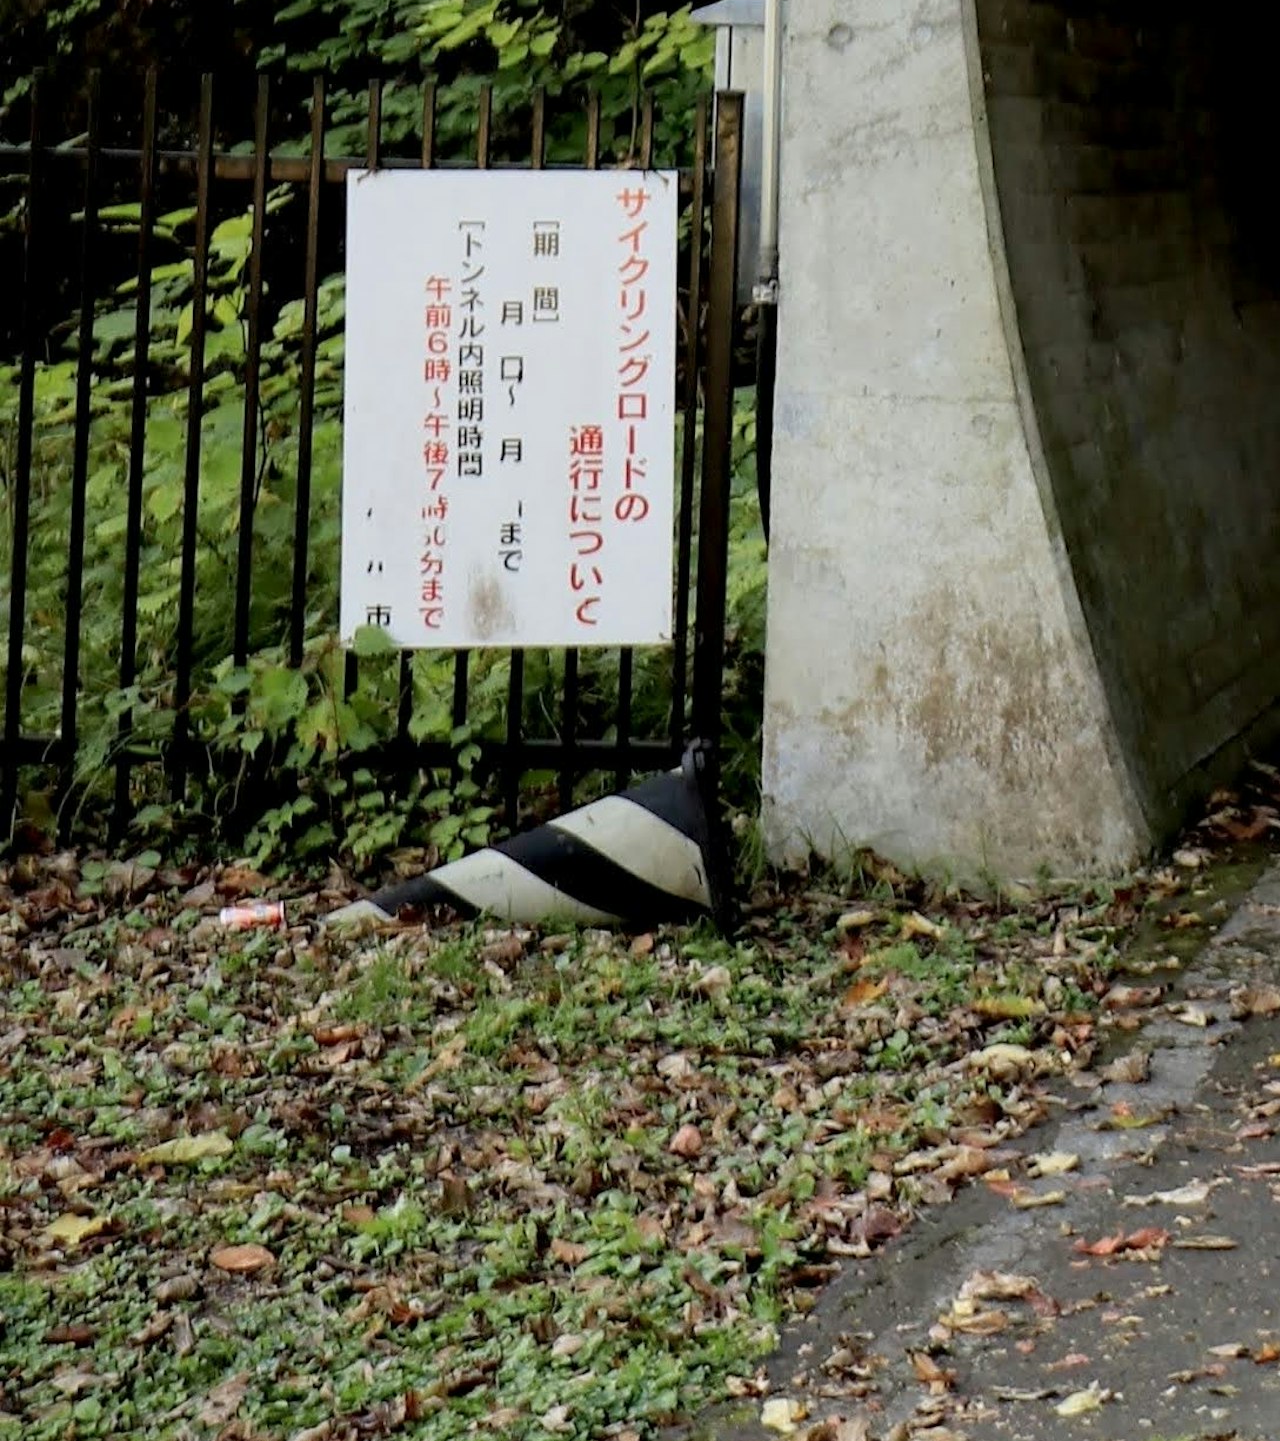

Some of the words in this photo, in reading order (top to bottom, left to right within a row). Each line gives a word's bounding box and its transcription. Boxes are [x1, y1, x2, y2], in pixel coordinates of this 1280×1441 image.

[614, 188, 651, 523] サイクリングロードの
